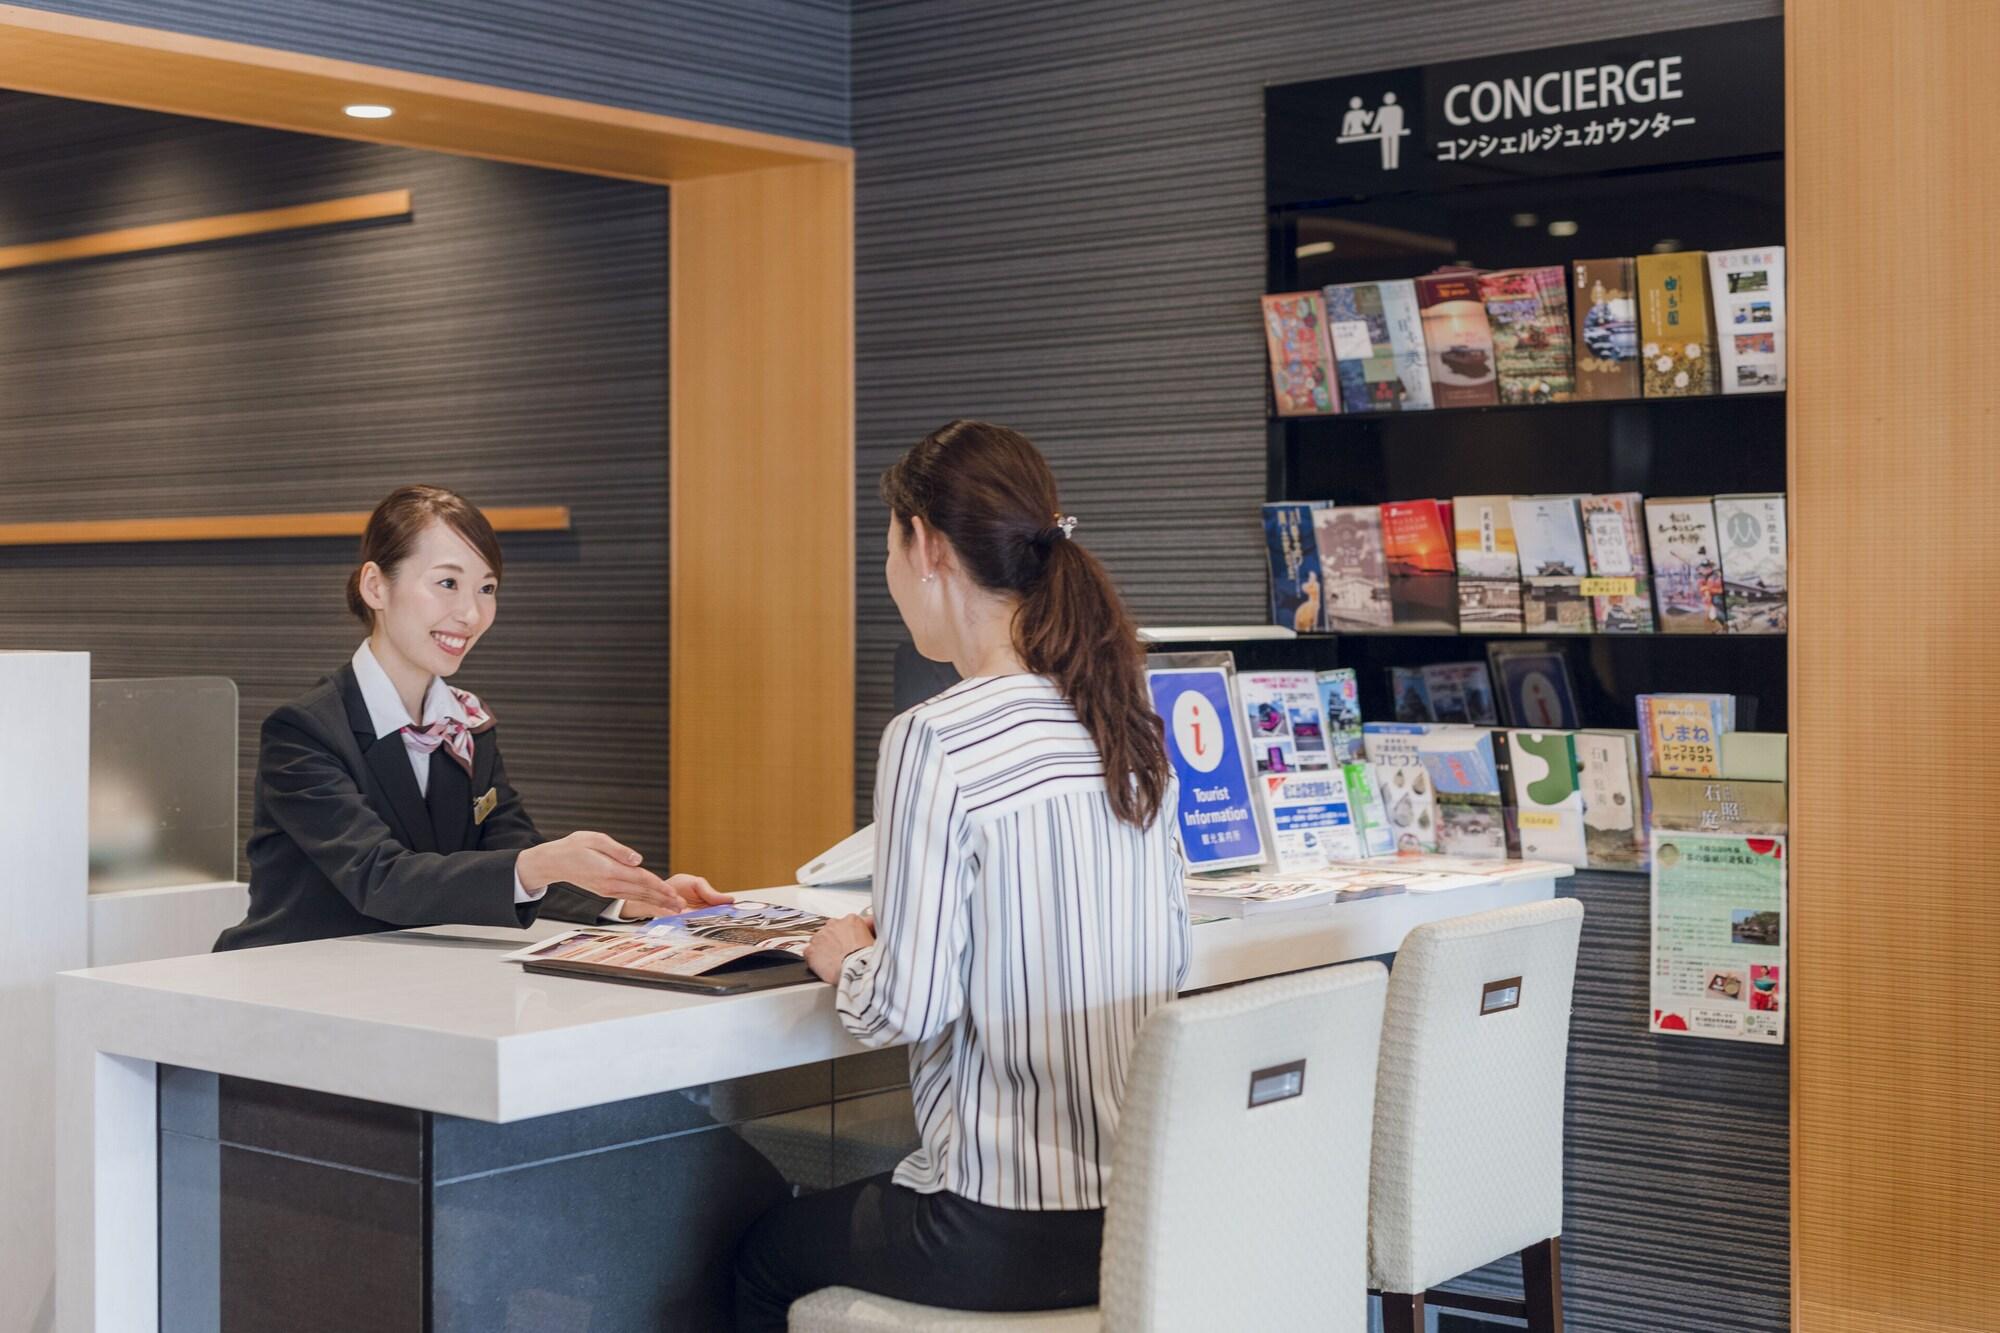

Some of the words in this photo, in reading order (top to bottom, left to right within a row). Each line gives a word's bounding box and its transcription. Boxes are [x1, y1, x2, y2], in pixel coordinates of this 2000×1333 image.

[1444, 56, 1683, 126] CONCIERGE
[1437, 112, 1696, 161] コンシェルジュカウンター
[1660, 723, 1710, 743] しまね
[1192, 786, 1230, 802] Tourist
[1184, 806, 1249, 826] Information
